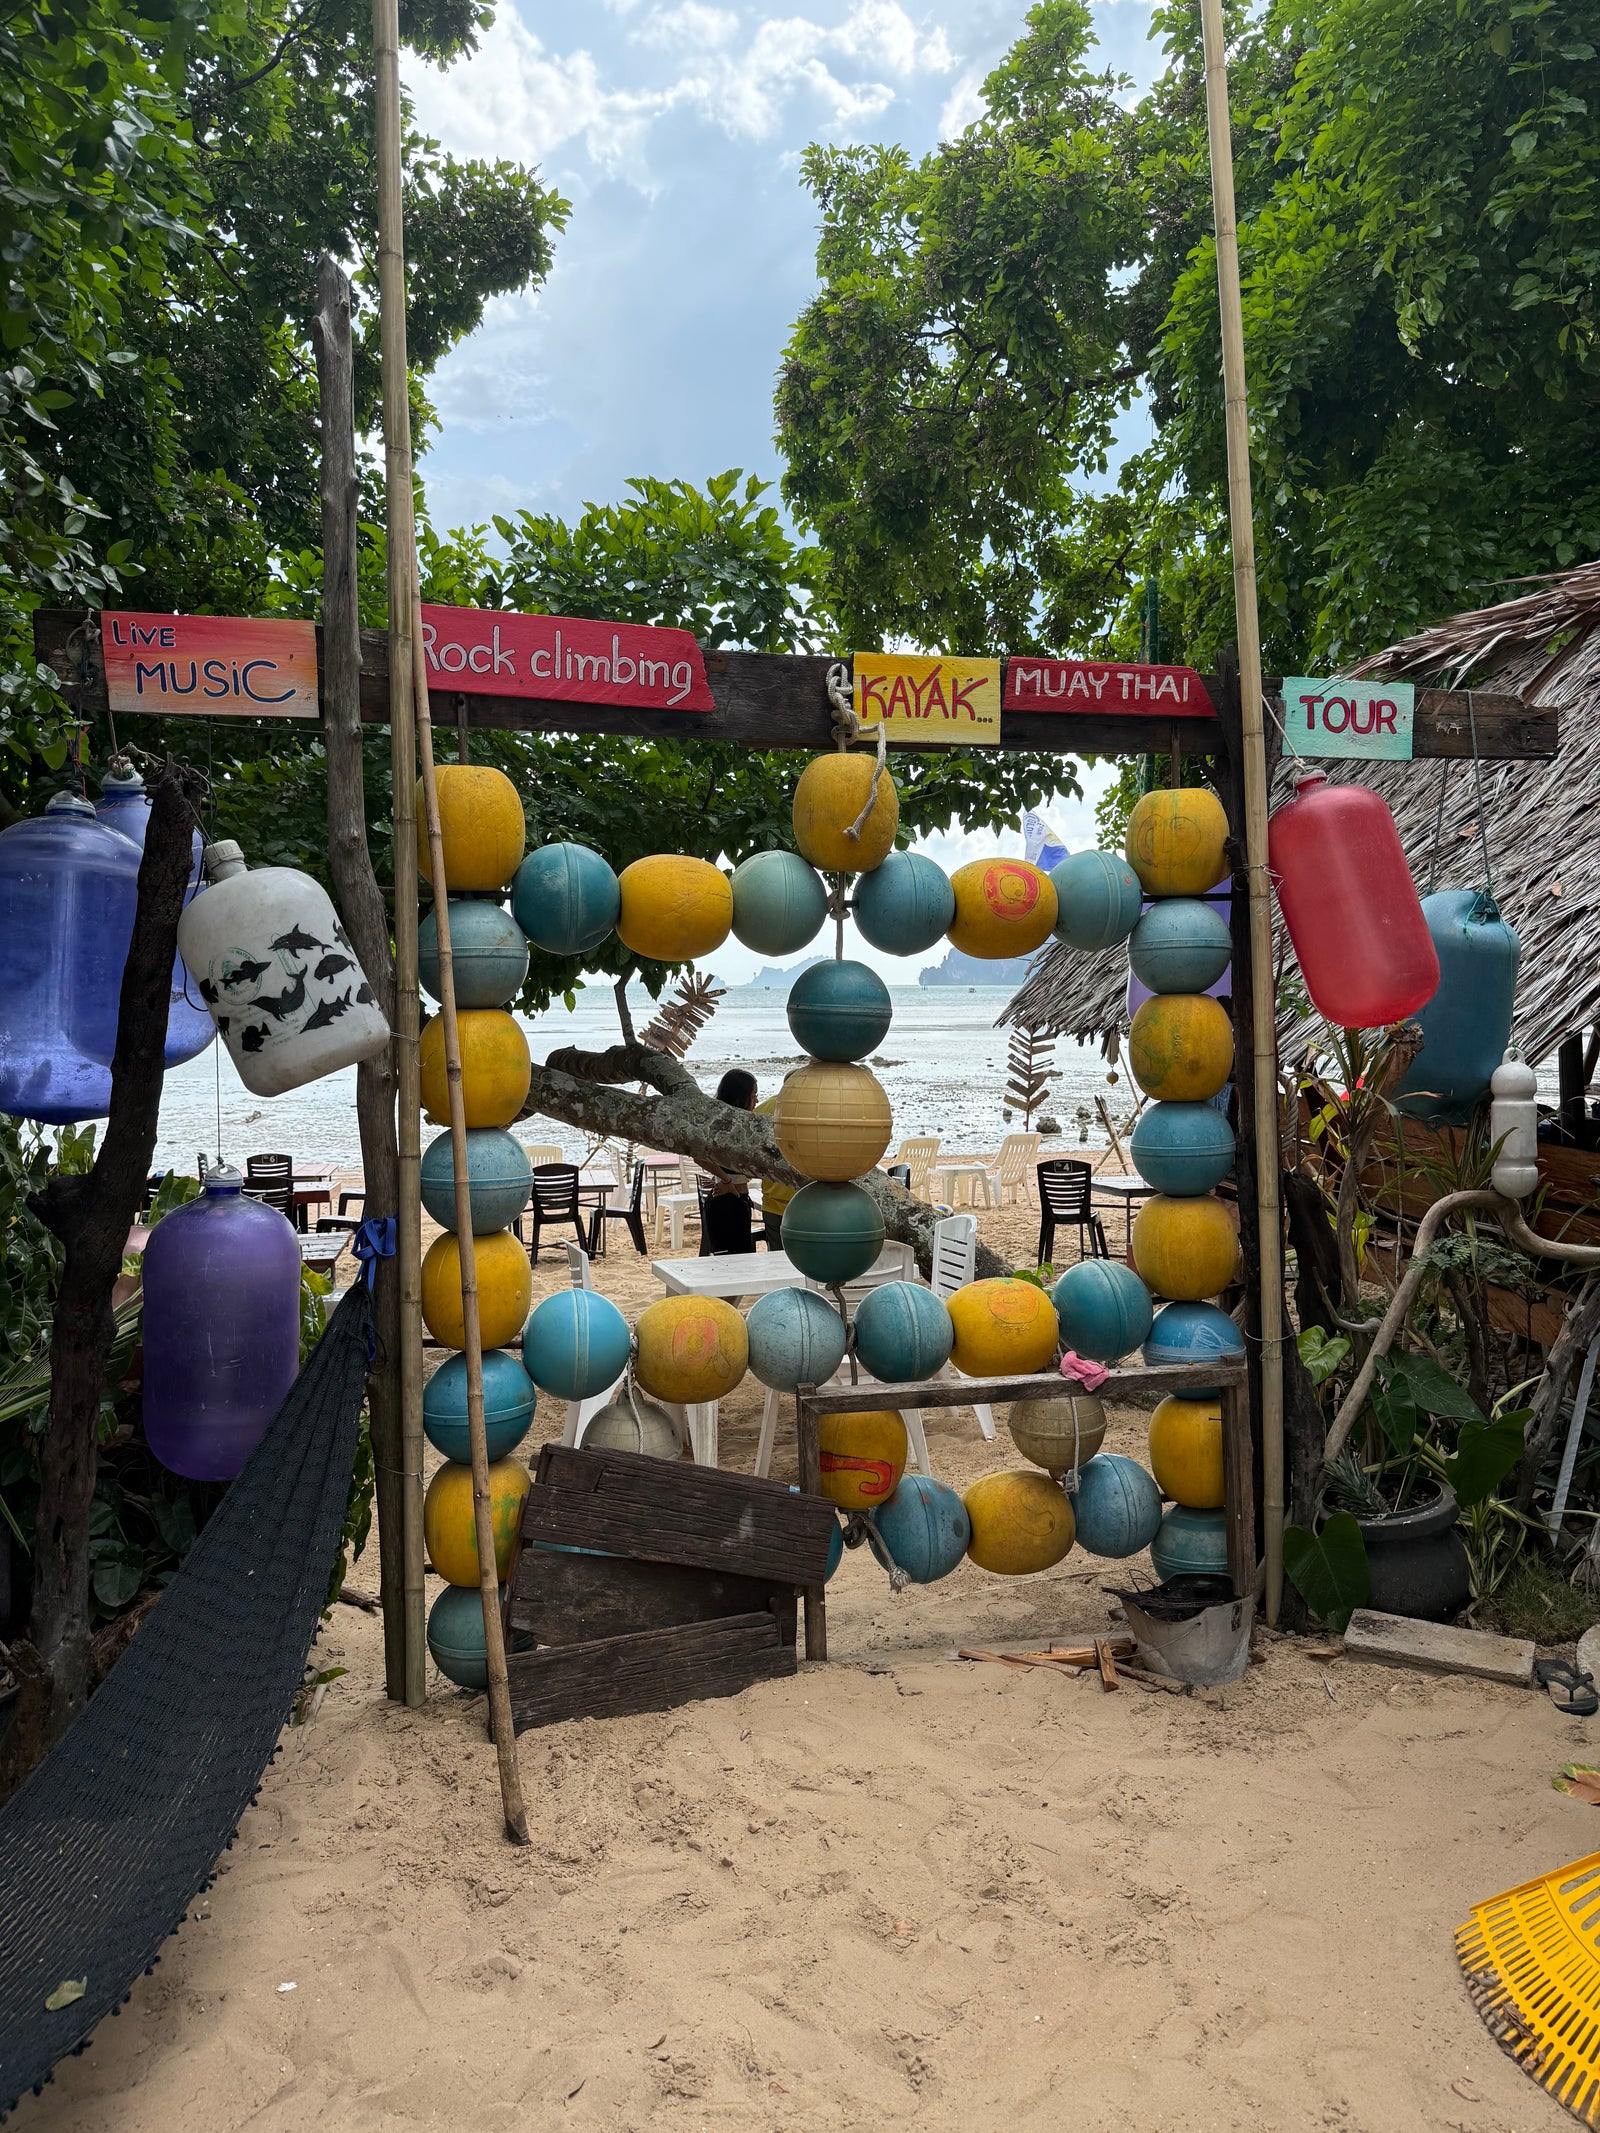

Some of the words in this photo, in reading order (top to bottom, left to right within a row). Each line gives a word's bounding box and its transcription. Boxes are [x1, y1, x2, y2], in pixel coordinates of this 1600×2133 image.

[422, 623, 516, 675] Rock
[530, 630, 693, 706] climbing
[1015, 667, 1110, 700] MUAY
[1117, 672, 1189, 702] THAI
[1299, 695, 1398, 735] TOUR
